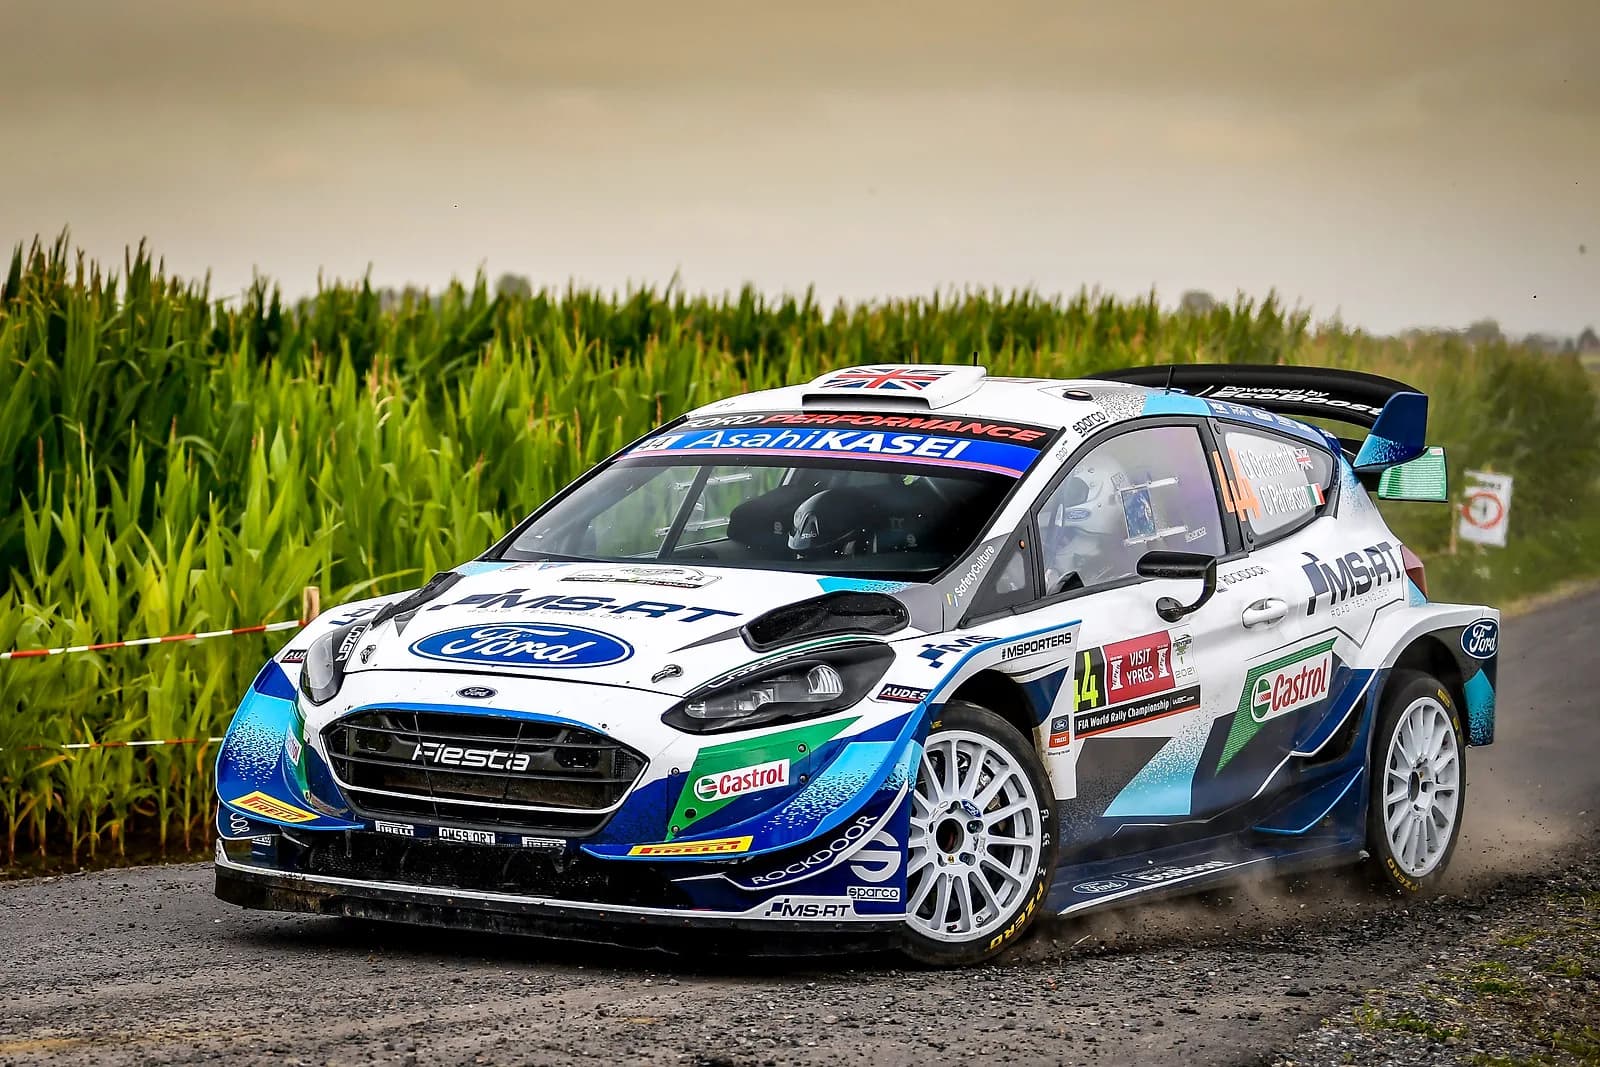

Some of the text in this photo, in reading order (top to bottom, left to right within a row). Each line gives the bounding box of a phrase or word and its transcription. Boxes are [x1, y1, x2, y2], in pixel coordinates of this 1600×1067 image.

[1209, 390, 1383, 416] EcoBoost
[1221, 385, 1330, 397] Powered by
[685, 413, 1047, 442] FORD PERFORMANCE
[1072, 411, 1107, 437] sparco
[954, 545, 995, 598] SafetyCulture
[1318, 541, 1402, 606] MS-RT
[472, 591, 744, 623] MS-RT
[440, 625, 597, 664] Ford
[1006, 631, 1072, 659] MSPORTERS
[1467, 622, 1498, 655] Ford
[1129, 648, 1152, 667] VISIT
[1126, 665, 1155, 686] YPRES
[1175, 667, 1196, 679] 2021
[1271, 657, 1329, 712] Castrol
[881, 686, 929, 700] AUDES
[1078, 719, 1090, 731] FIA
[1090, 713, 1110, 728] World
[1110, 709, 1127, 722] Rally
[1127, 698, 1170, 718] Championship
[411, 741, 531, 772] Fiesta
[718, 763, 785, 796] Castrol
[241, 796, 308, 821] PIRELLI
[751, 815, 879, 885] ROCKDOOR
[848, 887, 900, 901] sparco
[781, 904, 851, 918] MS-RT
